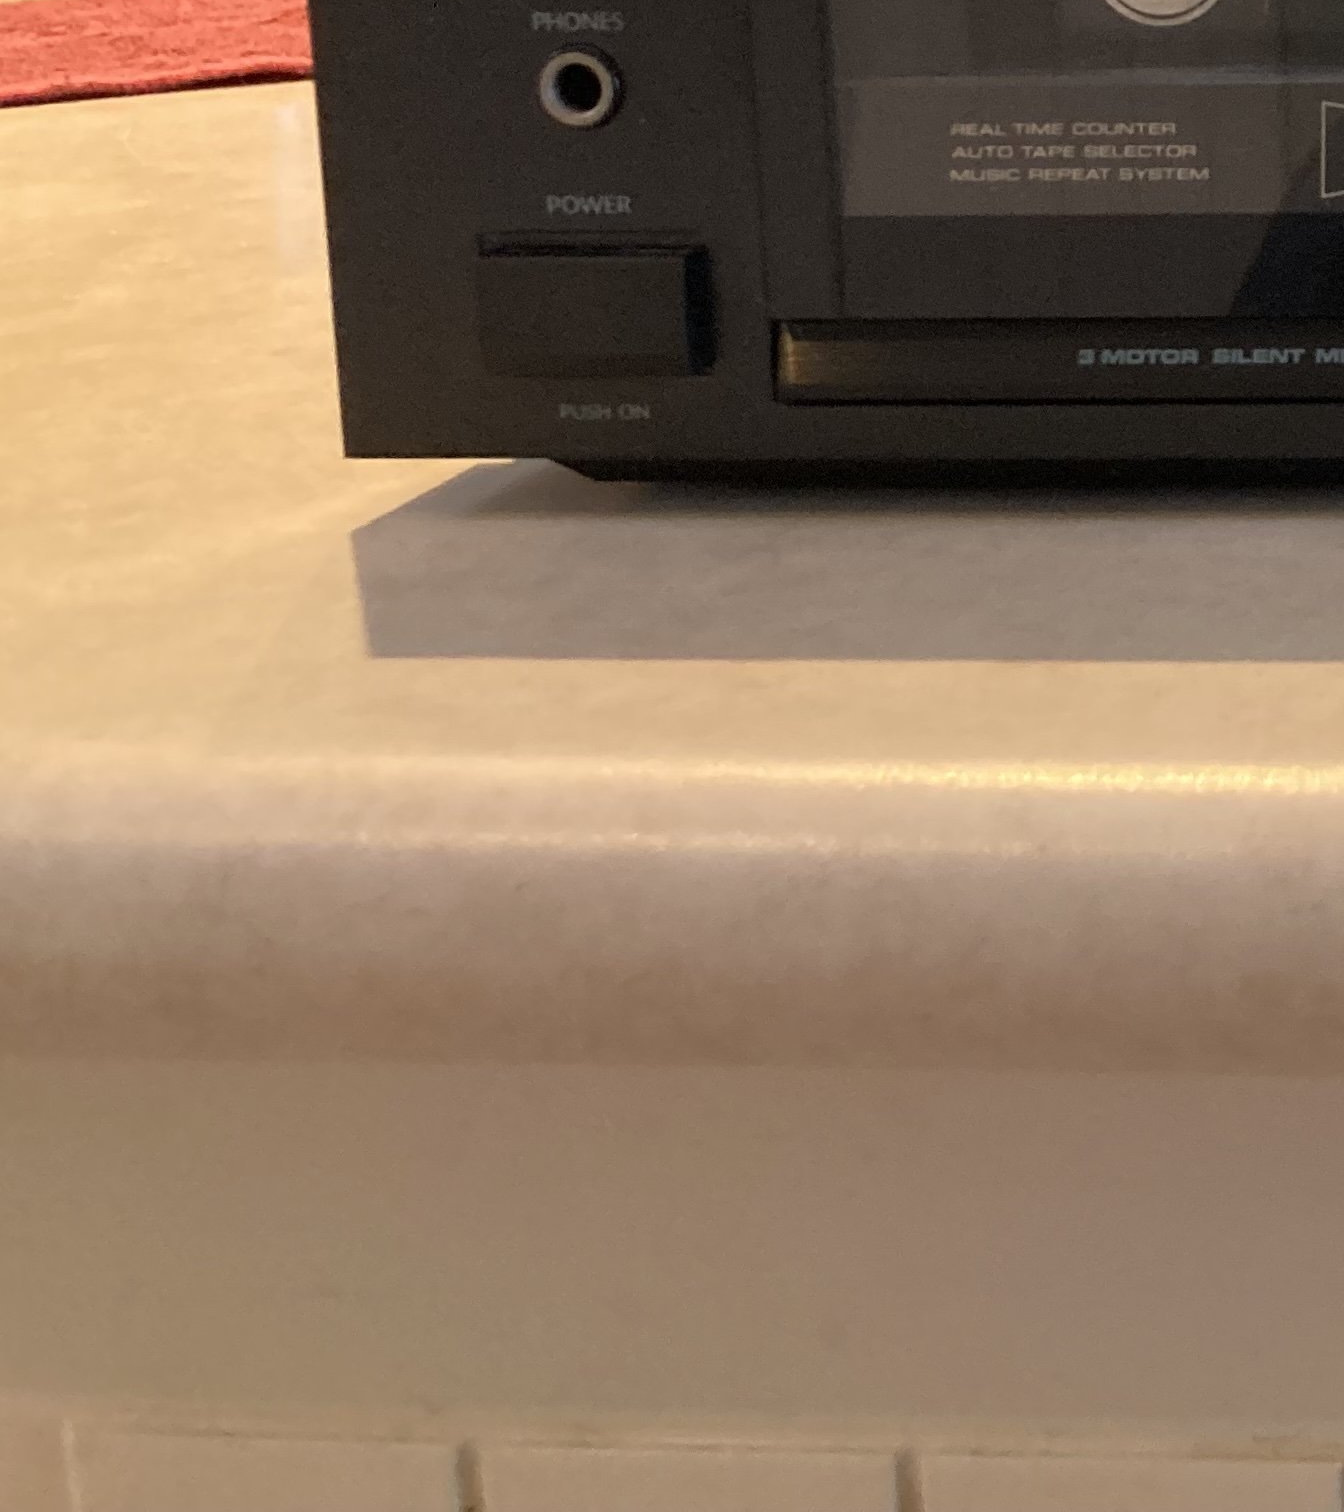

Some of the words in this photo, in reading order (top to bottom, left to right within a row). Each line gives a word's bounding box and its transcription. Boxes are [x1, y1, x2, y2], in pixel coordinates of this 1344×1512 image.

[530, 9, 626, 35] PHONES
[949, 122, 1007, 137] REAL
[1012, 122, 1064, 137] TIME
[1071, 121, 1177, 136] COUNTER
[950, 144, 1014, 159] AUTO
[1021, 144, 1076, 158] TAPE
[1083, 144, 1198, 158] SELECTOR
[949, 168, 1021, 182] MUSIC
[1027, 167, 1112, 181] REPEAT
[1118, 166, 1211, 181] SYSTEM
[544, 193, 634, 216] POWER
[1100, 348, 1200, 365] MOTOR
[1211, 347, 1305, 365] SILENT
[616, 402, 651, 421] ON
